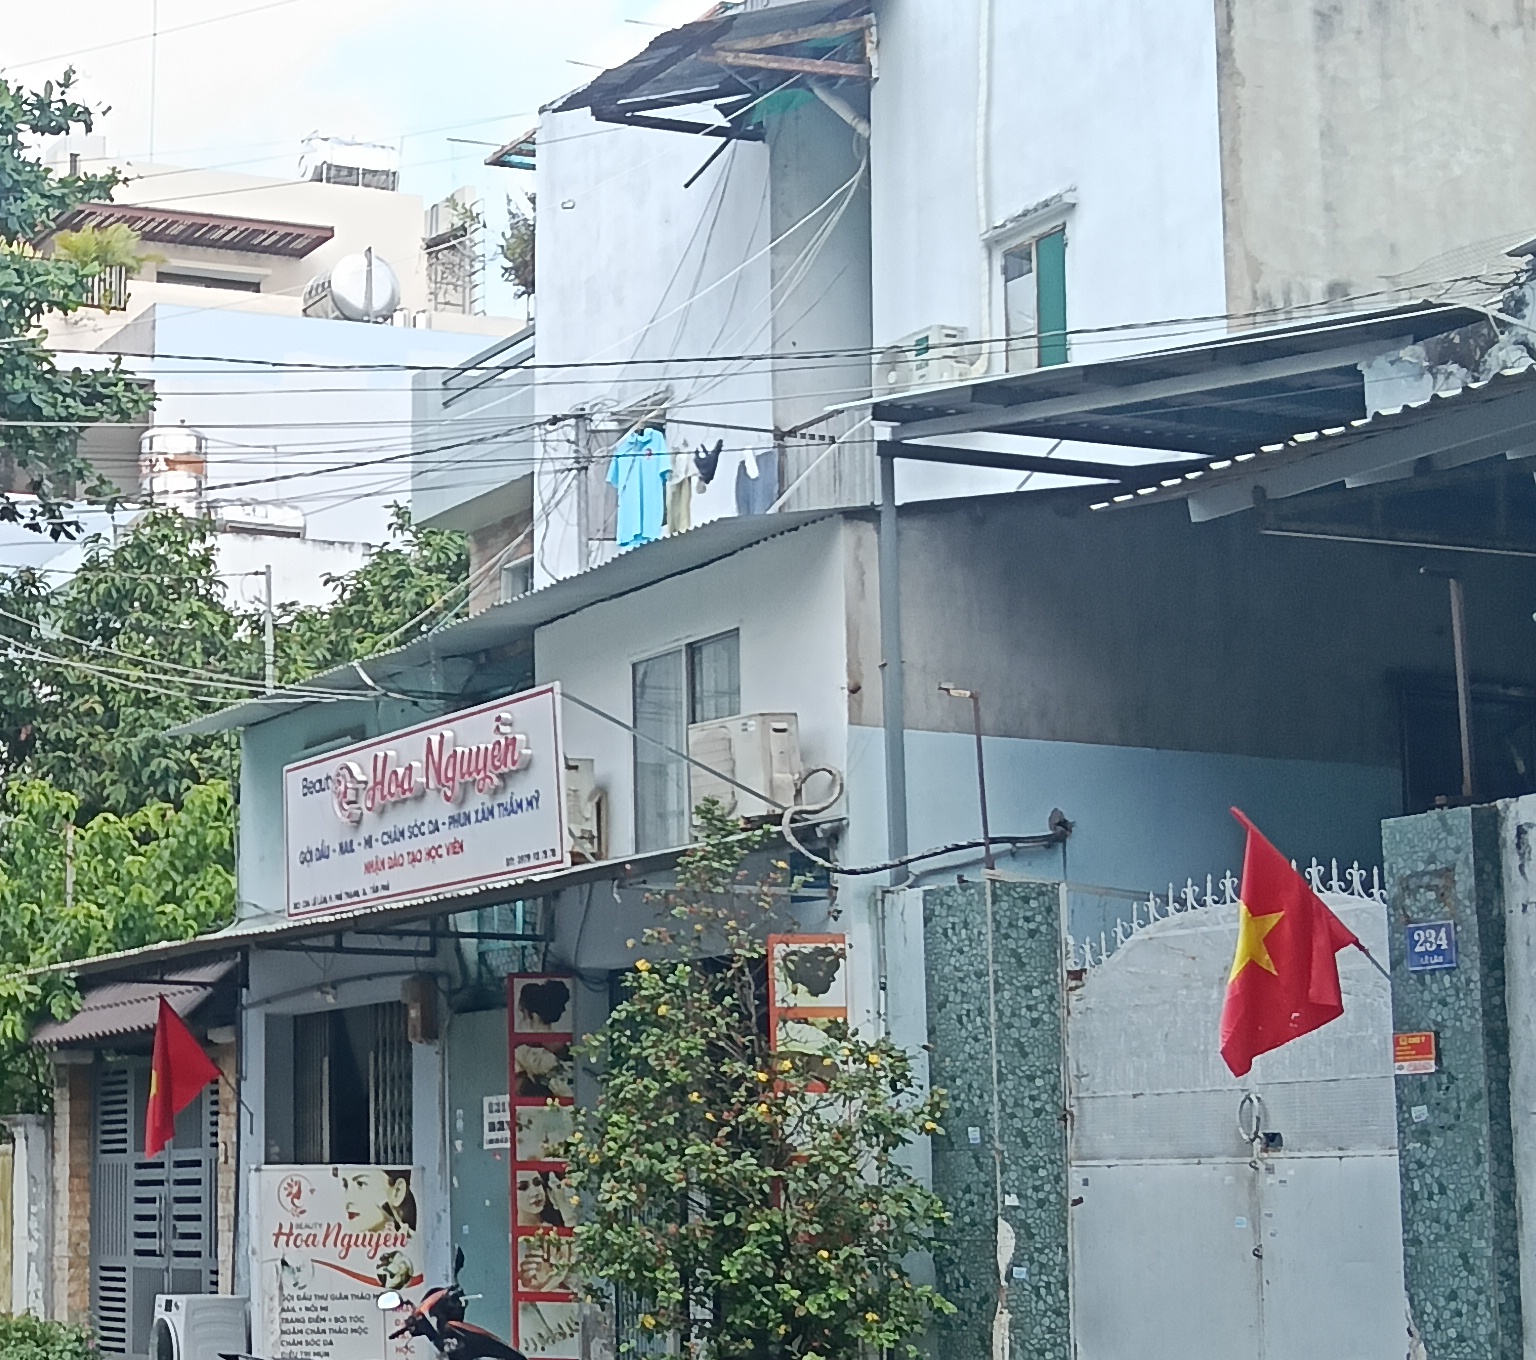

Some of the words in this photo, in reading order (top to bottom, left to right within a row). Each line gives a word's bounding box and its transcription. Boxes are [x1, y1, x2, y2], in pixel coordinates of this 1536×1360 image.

[365, 751, 416, 812] Hoa
[1414, 927, 1448, 952] 234
[272, 1222, 318, 1248] Hoa
[395, 1345, 415, 1355] HỌC
